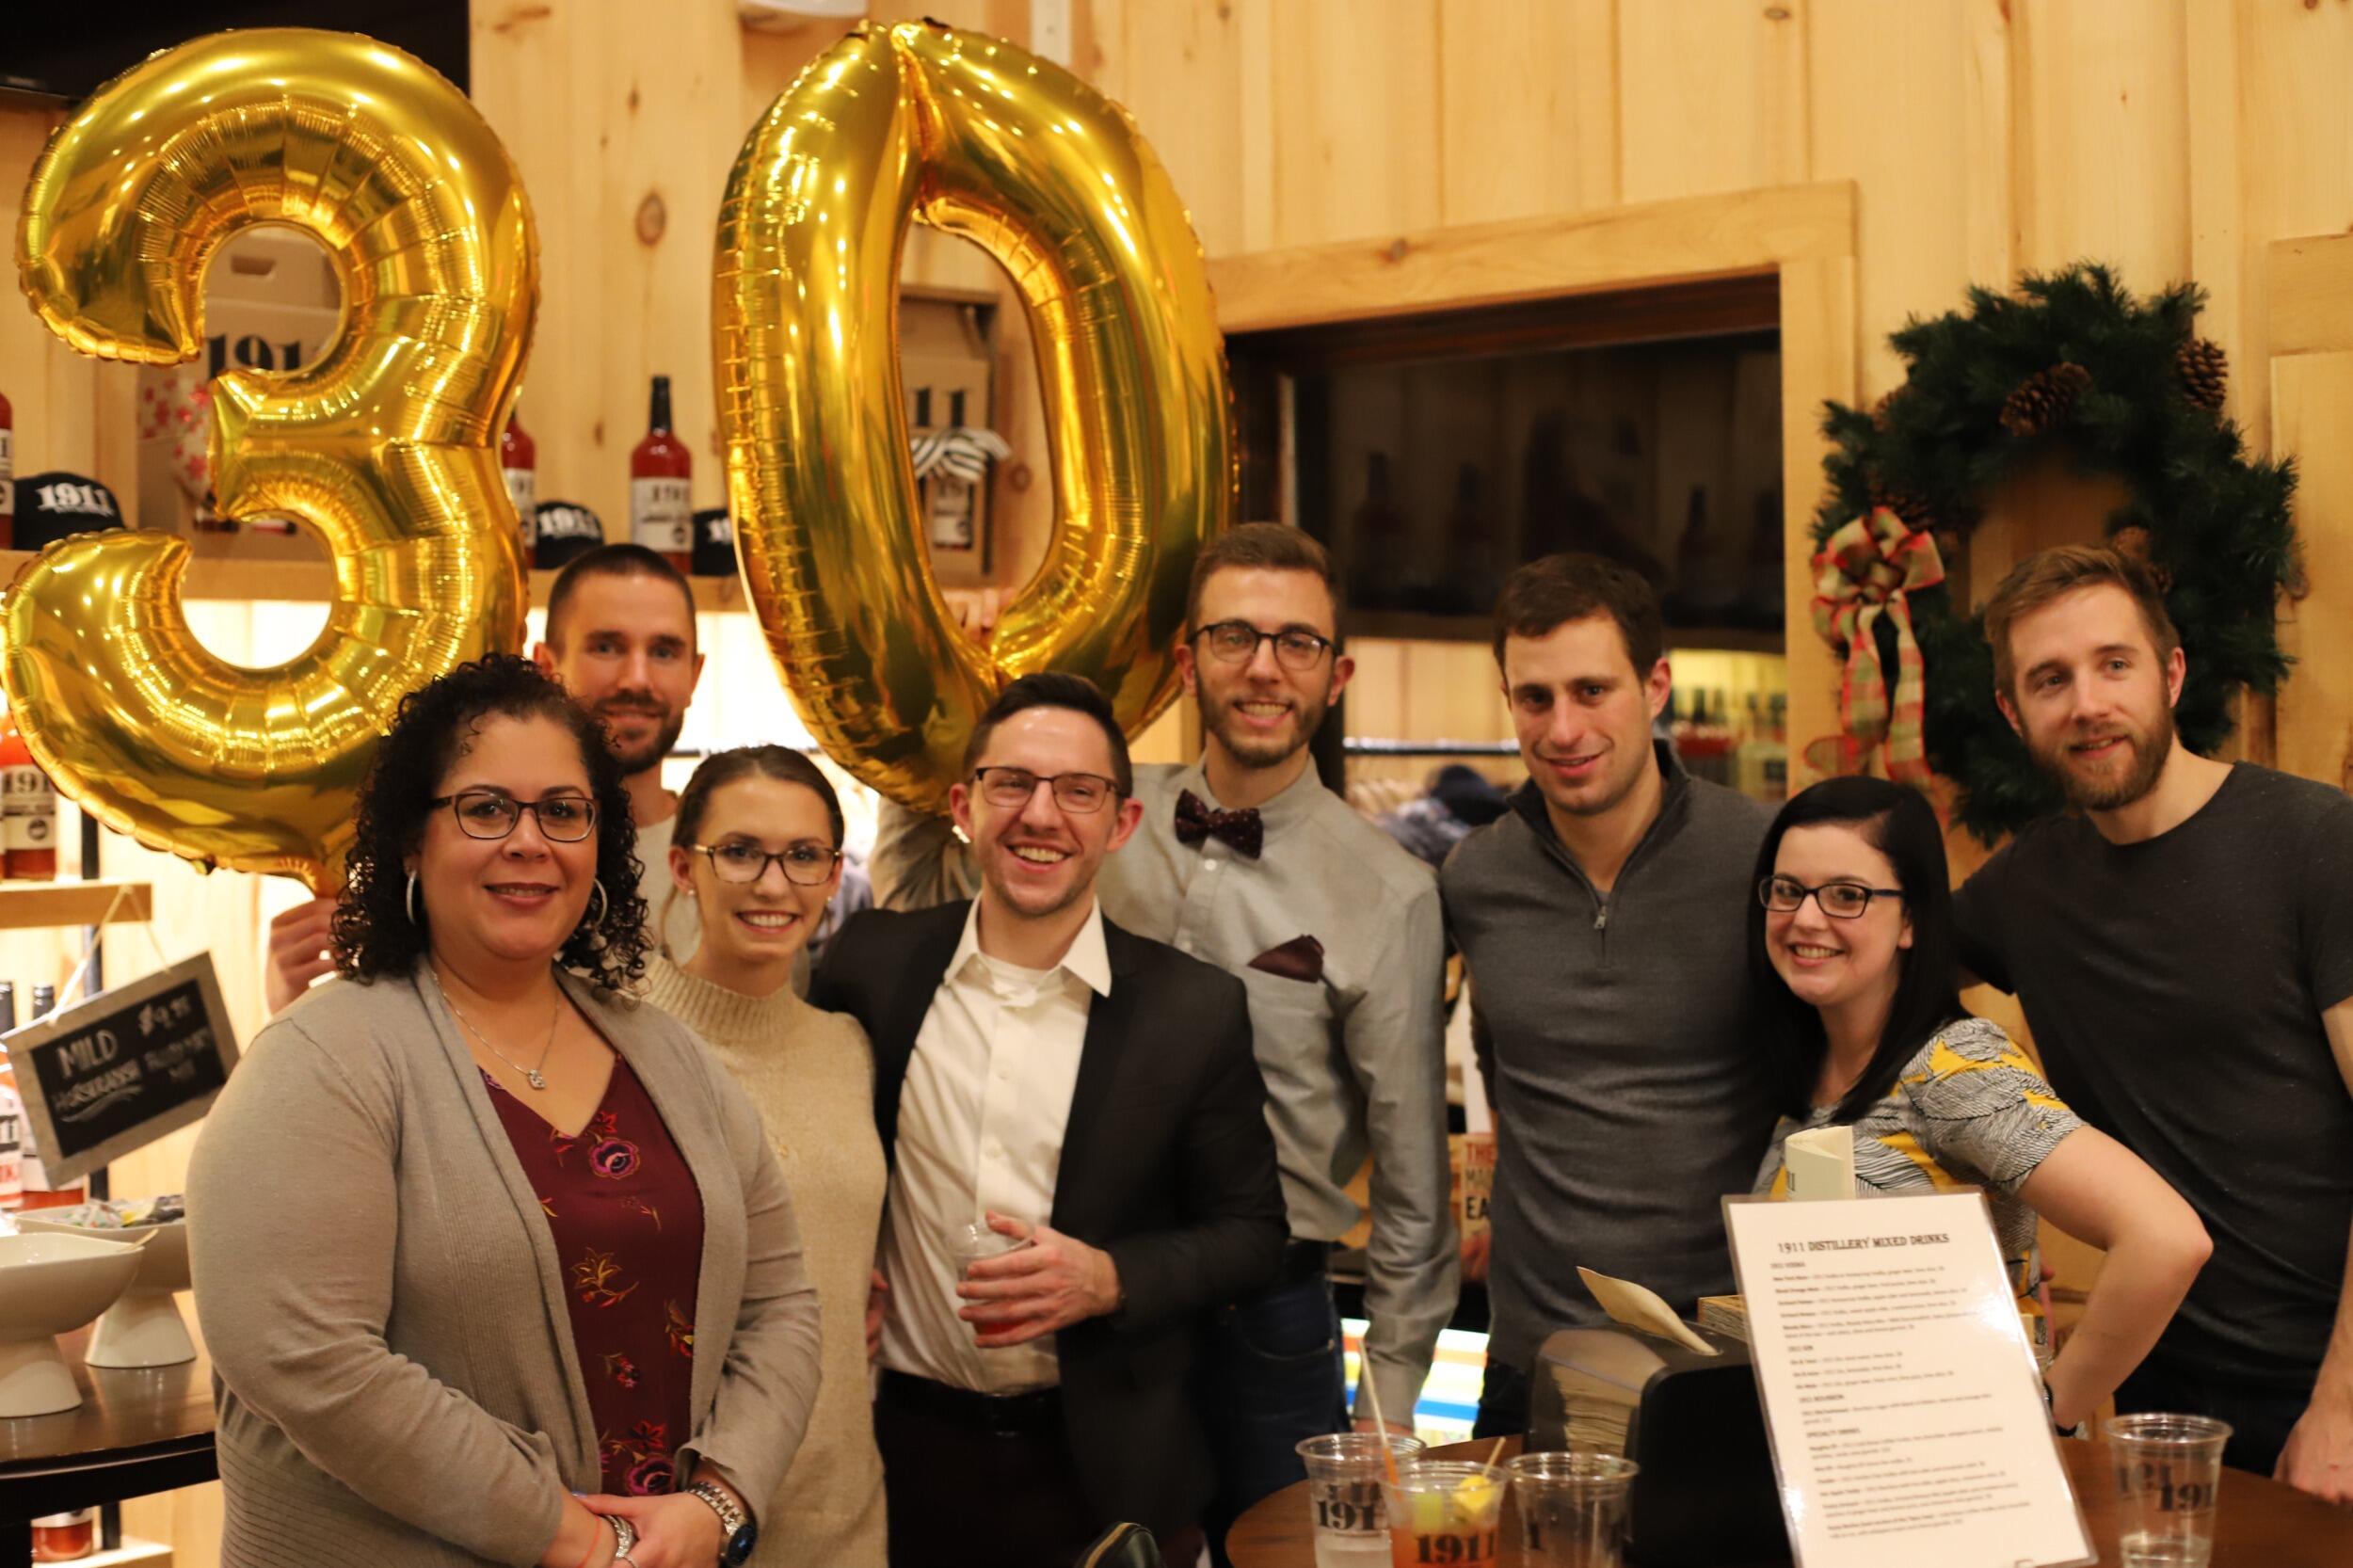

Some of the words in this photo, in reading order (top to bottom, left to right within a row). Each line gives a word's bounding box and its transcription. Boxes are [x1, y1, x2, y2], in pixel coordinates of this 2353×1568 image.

[206, 332, 305, 379] 191
[37, 482, 113, 516] 1911
[4, 771, 50, 793] 191
[56, 1029, 118, 1080] MILD
[1465, 1195, 1491, 1221] EA
[1777, 1240, 1805, 1255] 1911
[1807, 1237, 1870, 1253] DISTILLERY
[1871, 1235, 1907, 1249] MIXED
[1909, 1233, 1950, 1246] DRINKS
